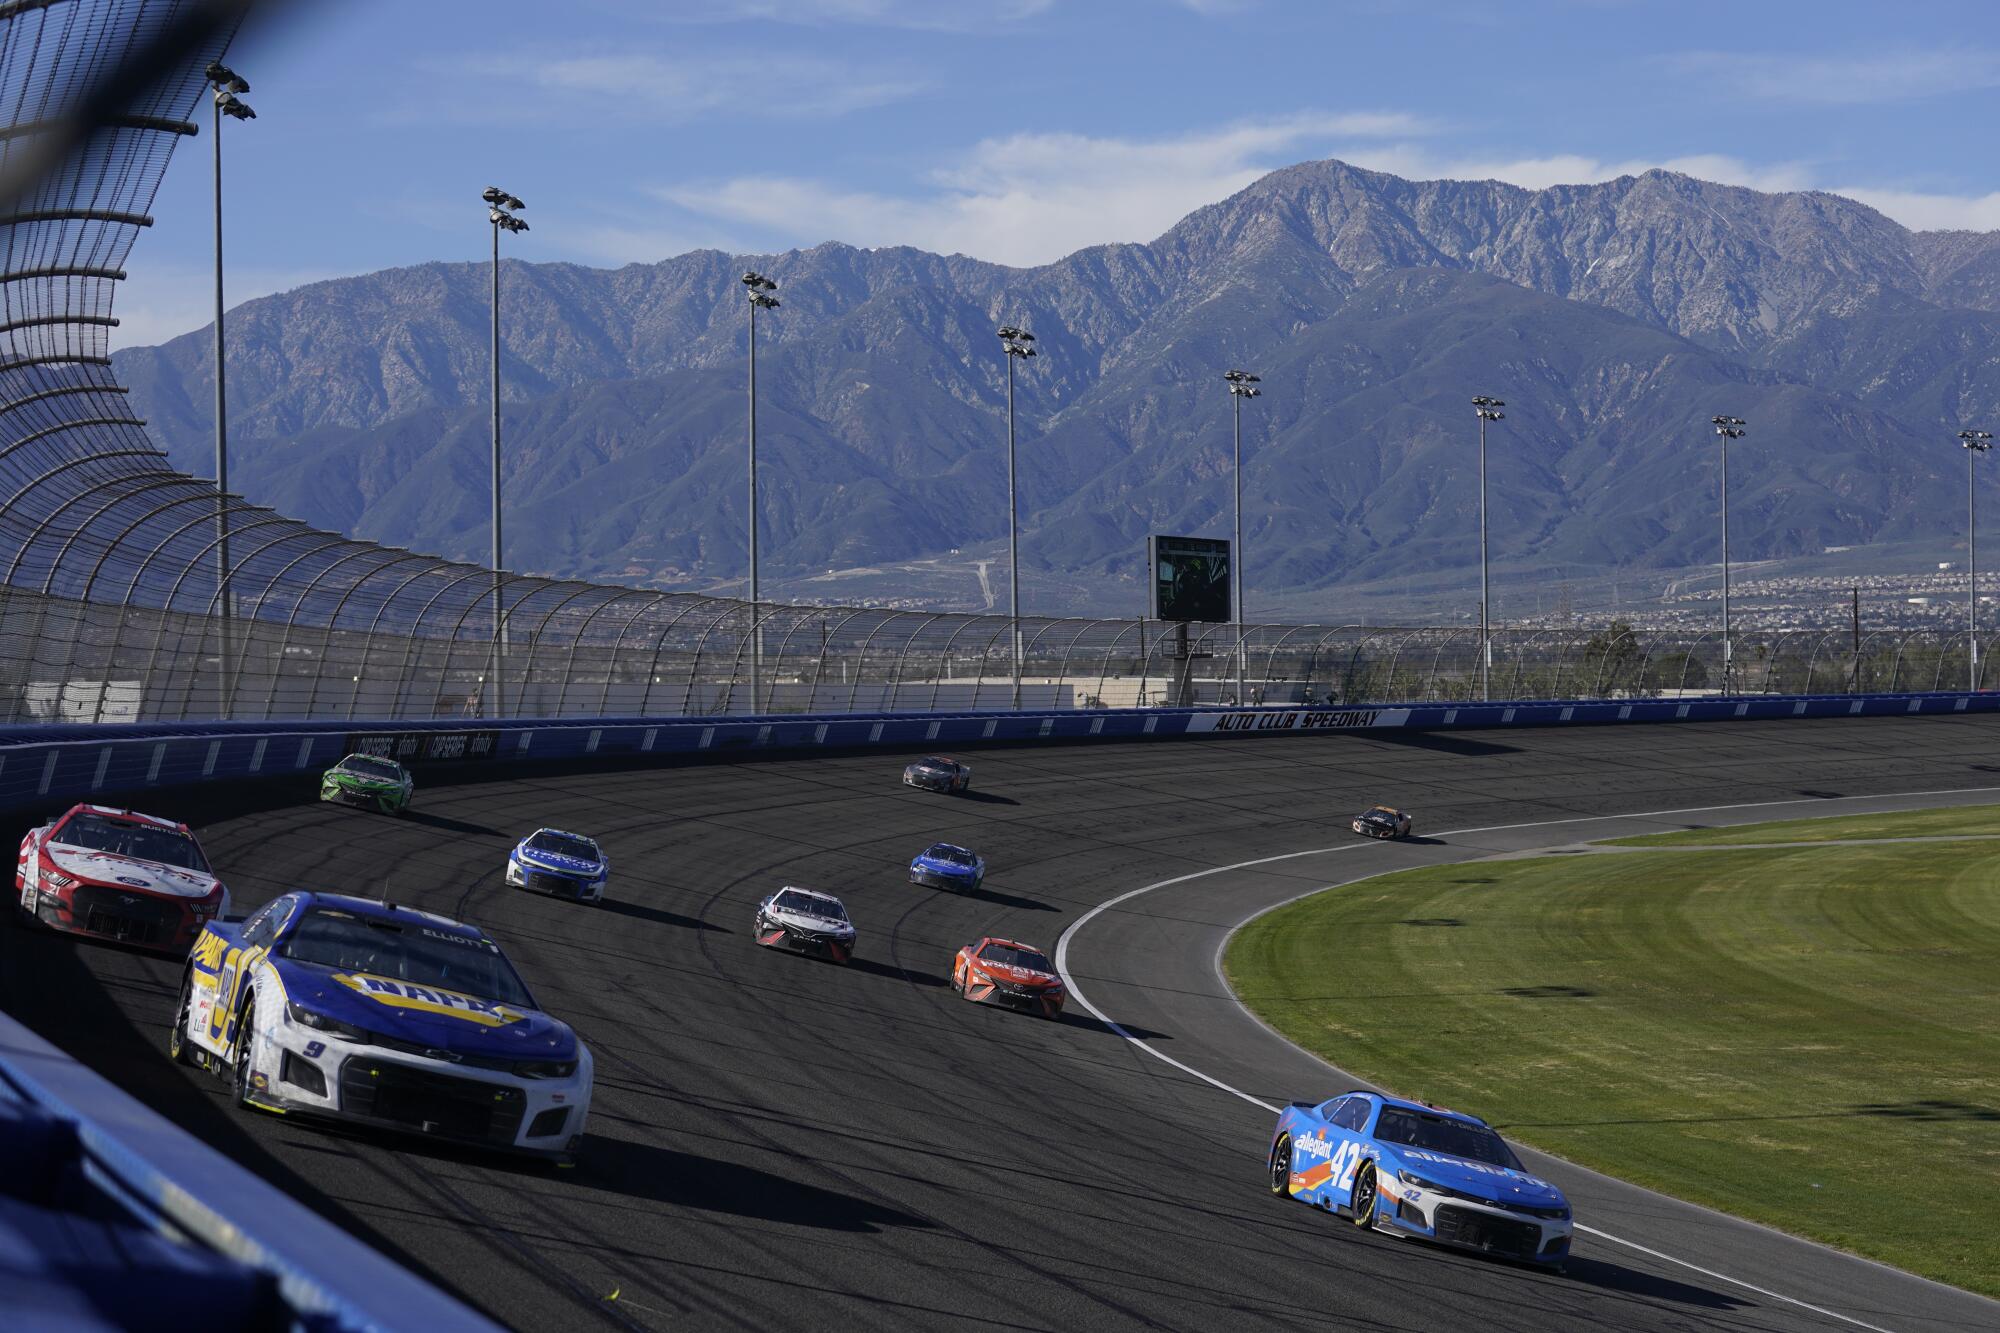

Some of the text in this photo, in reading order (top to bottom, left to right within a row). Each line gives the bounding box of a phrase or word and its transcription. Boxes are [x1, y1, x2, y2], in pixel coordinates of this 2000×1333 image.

[1213, 711, 1381, 730] AUTO CLUB SPEEDWAY
[119, 877, 146, 886] Ford
[422, 928, 483, 948] ELLIOTT
[351, 976, 512, 1022] NAPA
[303, 1040, 326, 1058] 9
[1294, 1131, 1333, 1159] allegiant
[1330, 1139, 1360, 1192] 42
[1404, 1149, 1548, 1188] allegiant
[1403, 1189, 1422, 1202] 42
